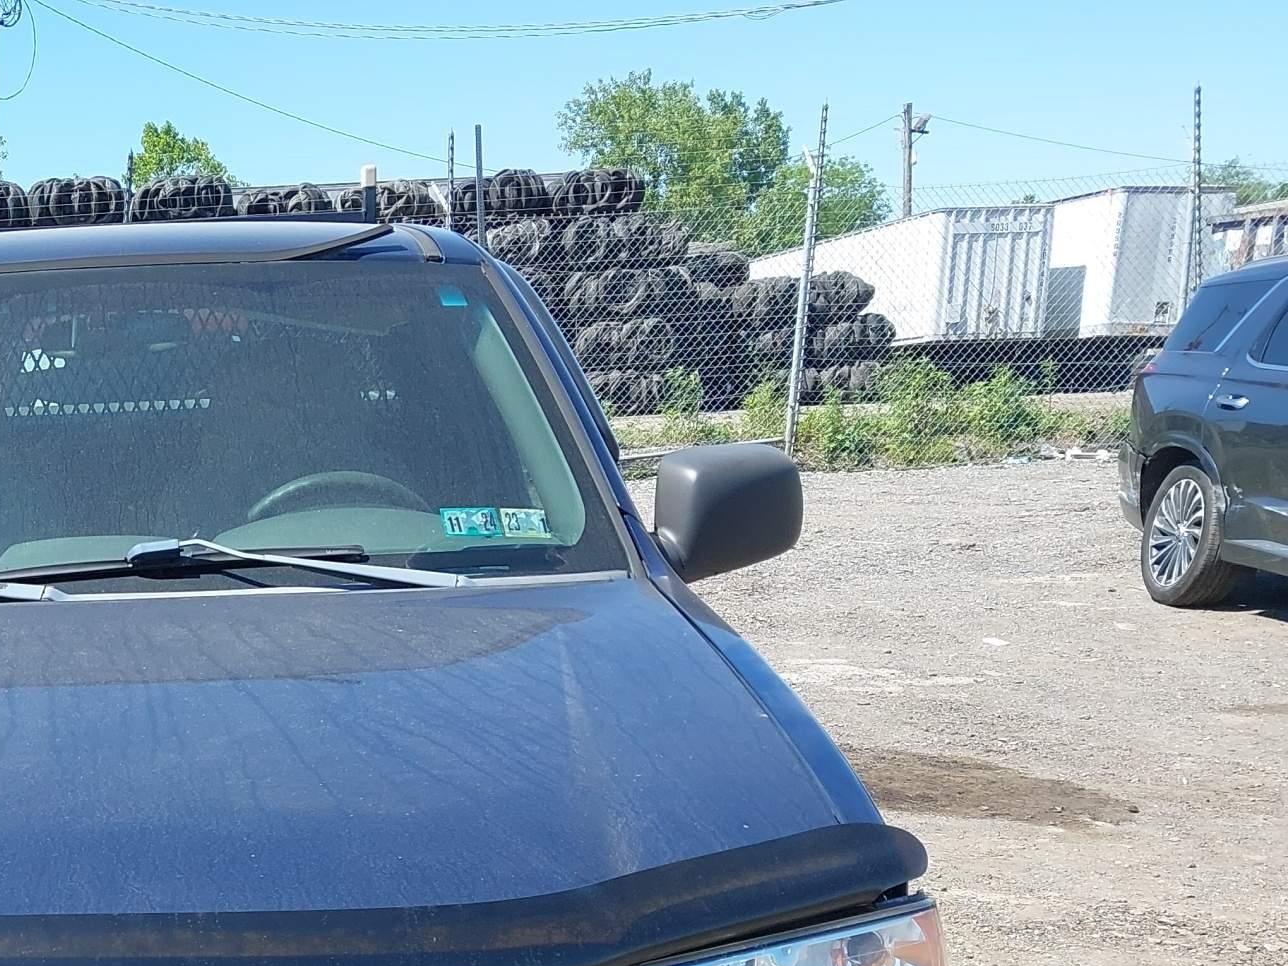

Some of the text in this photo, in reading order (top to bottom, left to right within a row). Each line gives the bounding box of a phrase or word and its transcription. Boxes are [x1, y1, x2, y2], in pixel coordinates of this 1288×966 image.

[447, 512, 497, 532] 11 24
[505, 512, 520, 531] 23
